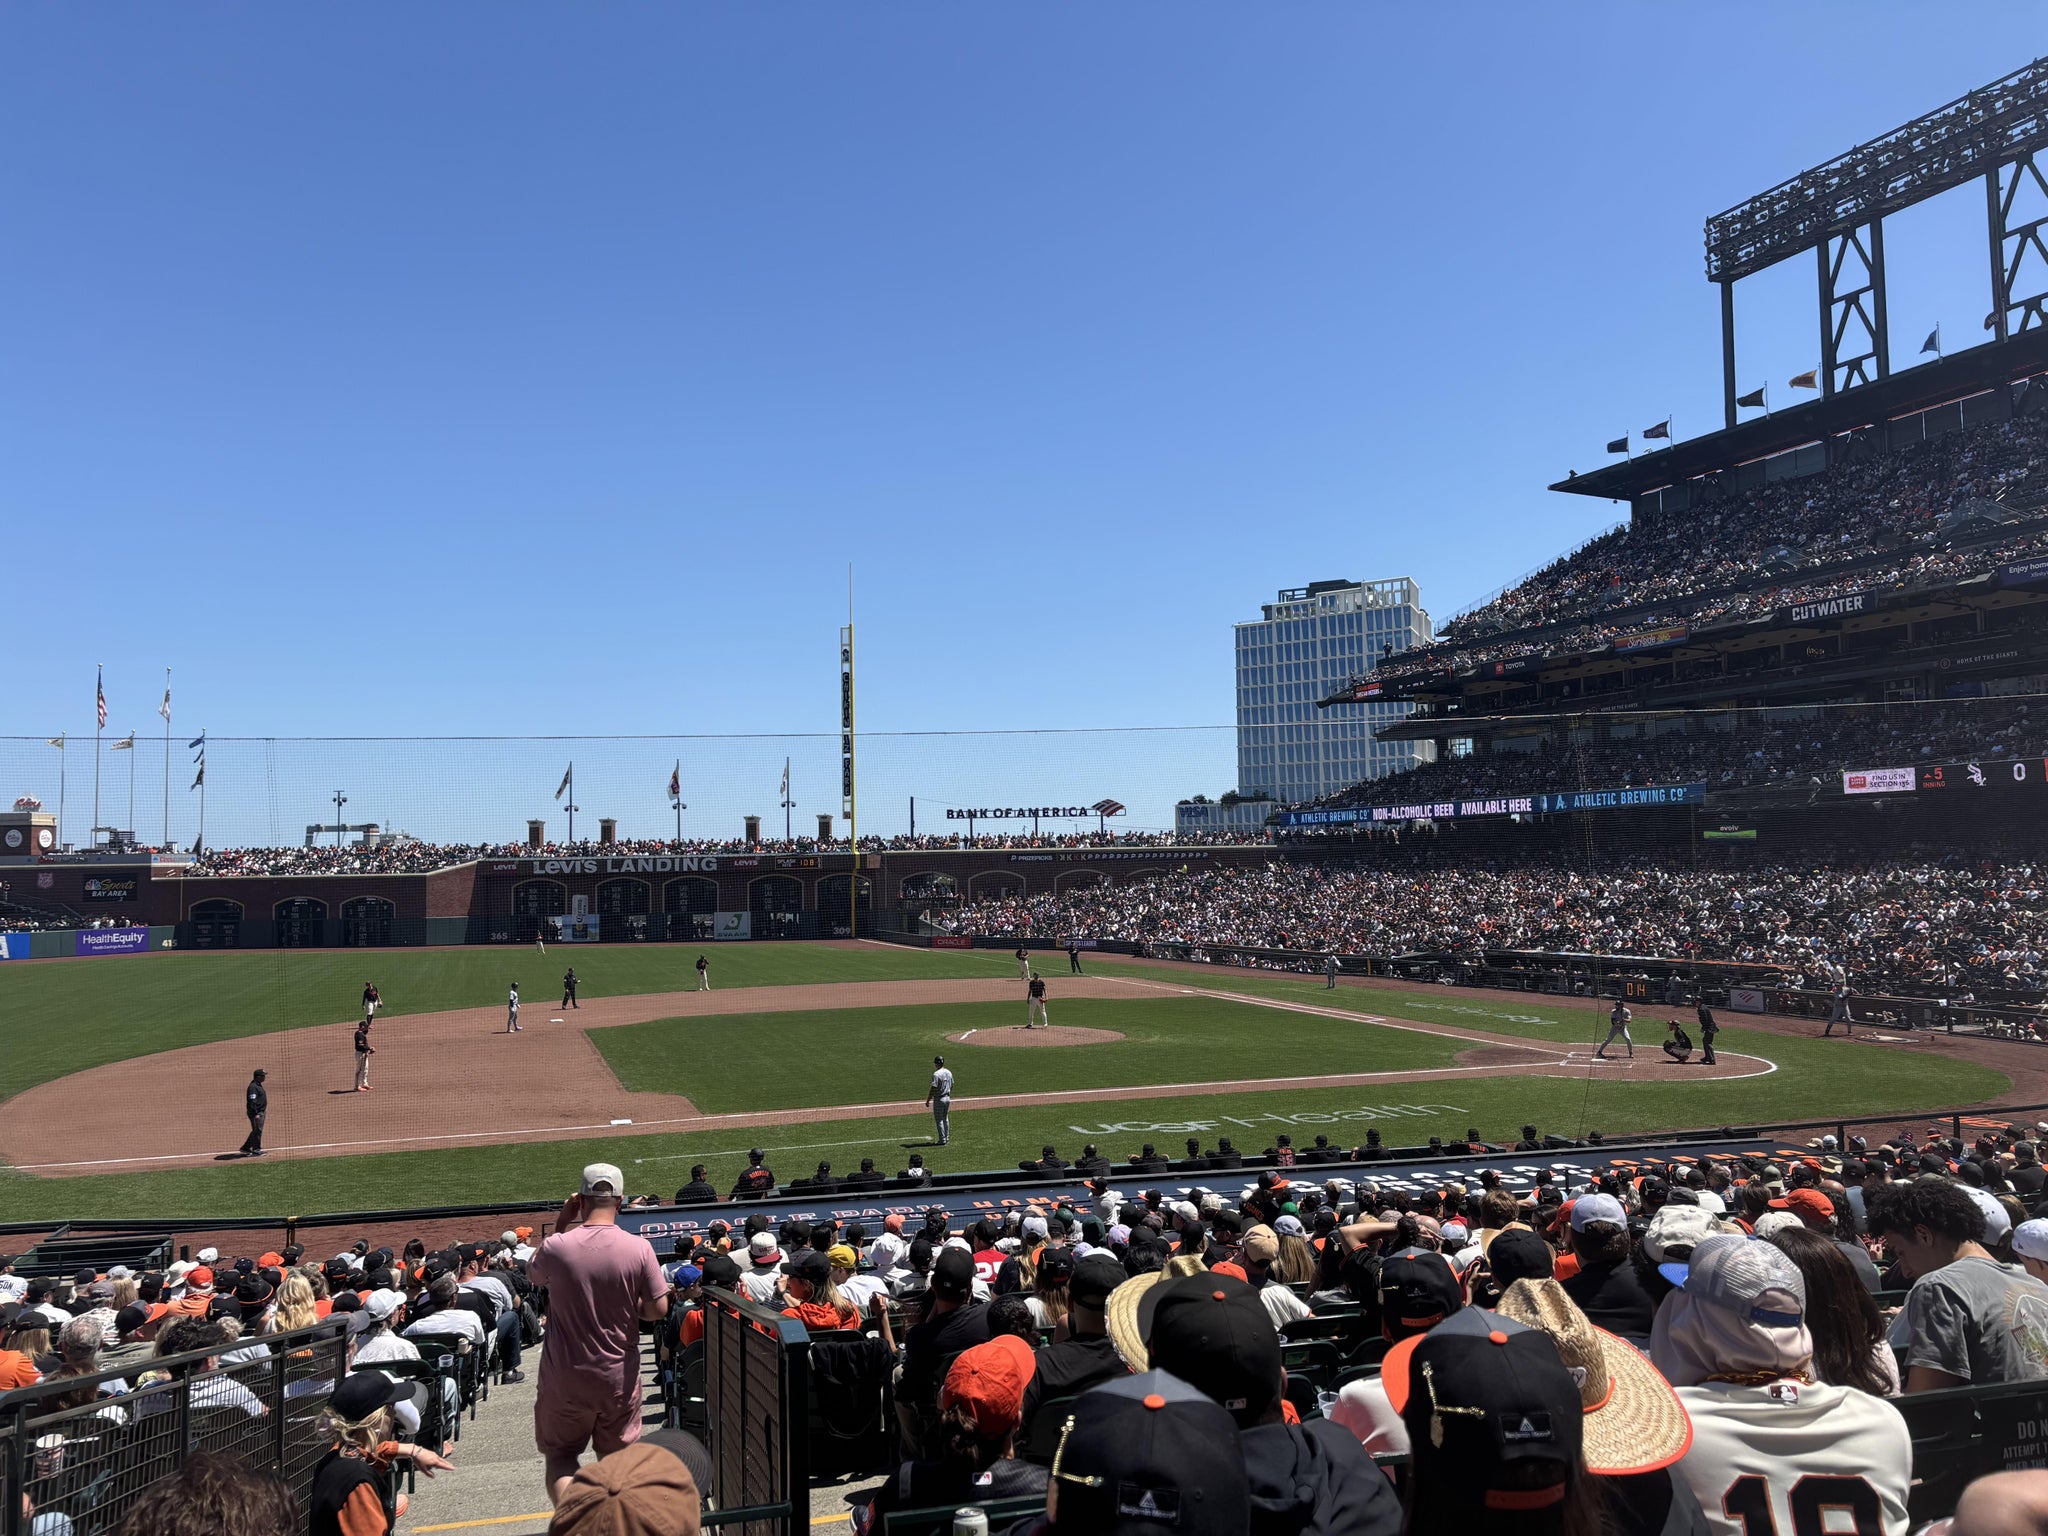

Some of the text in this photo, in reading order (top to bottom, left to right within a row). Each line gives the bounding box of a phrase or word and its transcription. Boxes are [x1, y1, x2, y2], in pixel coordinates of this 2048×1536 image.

[2009, 565, 2029, 574] Enjoy
[1792, 595, 1863, 621] CUTWATER
[1505, 661, 1526, 670] TOYOTA
[1934, 767, 1943, 780] 5
[2013, 763, 2026, 781] 0
[1870, 780, 1898, 788] SECTION
[1574, 792, 1617, 808] ATHLETIC
[1620, 789, 1665, 805] BREWING
[946, 806, 1088, 820] BANK OF AMERICA
[1179, 806, 1209, 818] VISA
[1372, 798, 1532, 821] NON-ALCOHOLIC BEER AVAILABLE HERE
[1301, 813, 1328, 823] ATHLETIC
[1329, 812, 1357, 822] BREWING
[606, 857, 718, 873] LANDING
[91, 889, 128, 898] BAY AREA
[490, 932, 508, 940] 365
[833, 927, 850, 935] 309
[83, 932, 144, 945] HealthEquity
[1219, 1103, 1470, 1129] Health
[2018, 1420, 2036, 1440] DO
[2003, 1443, 2041, 1460] ATTEMPT
